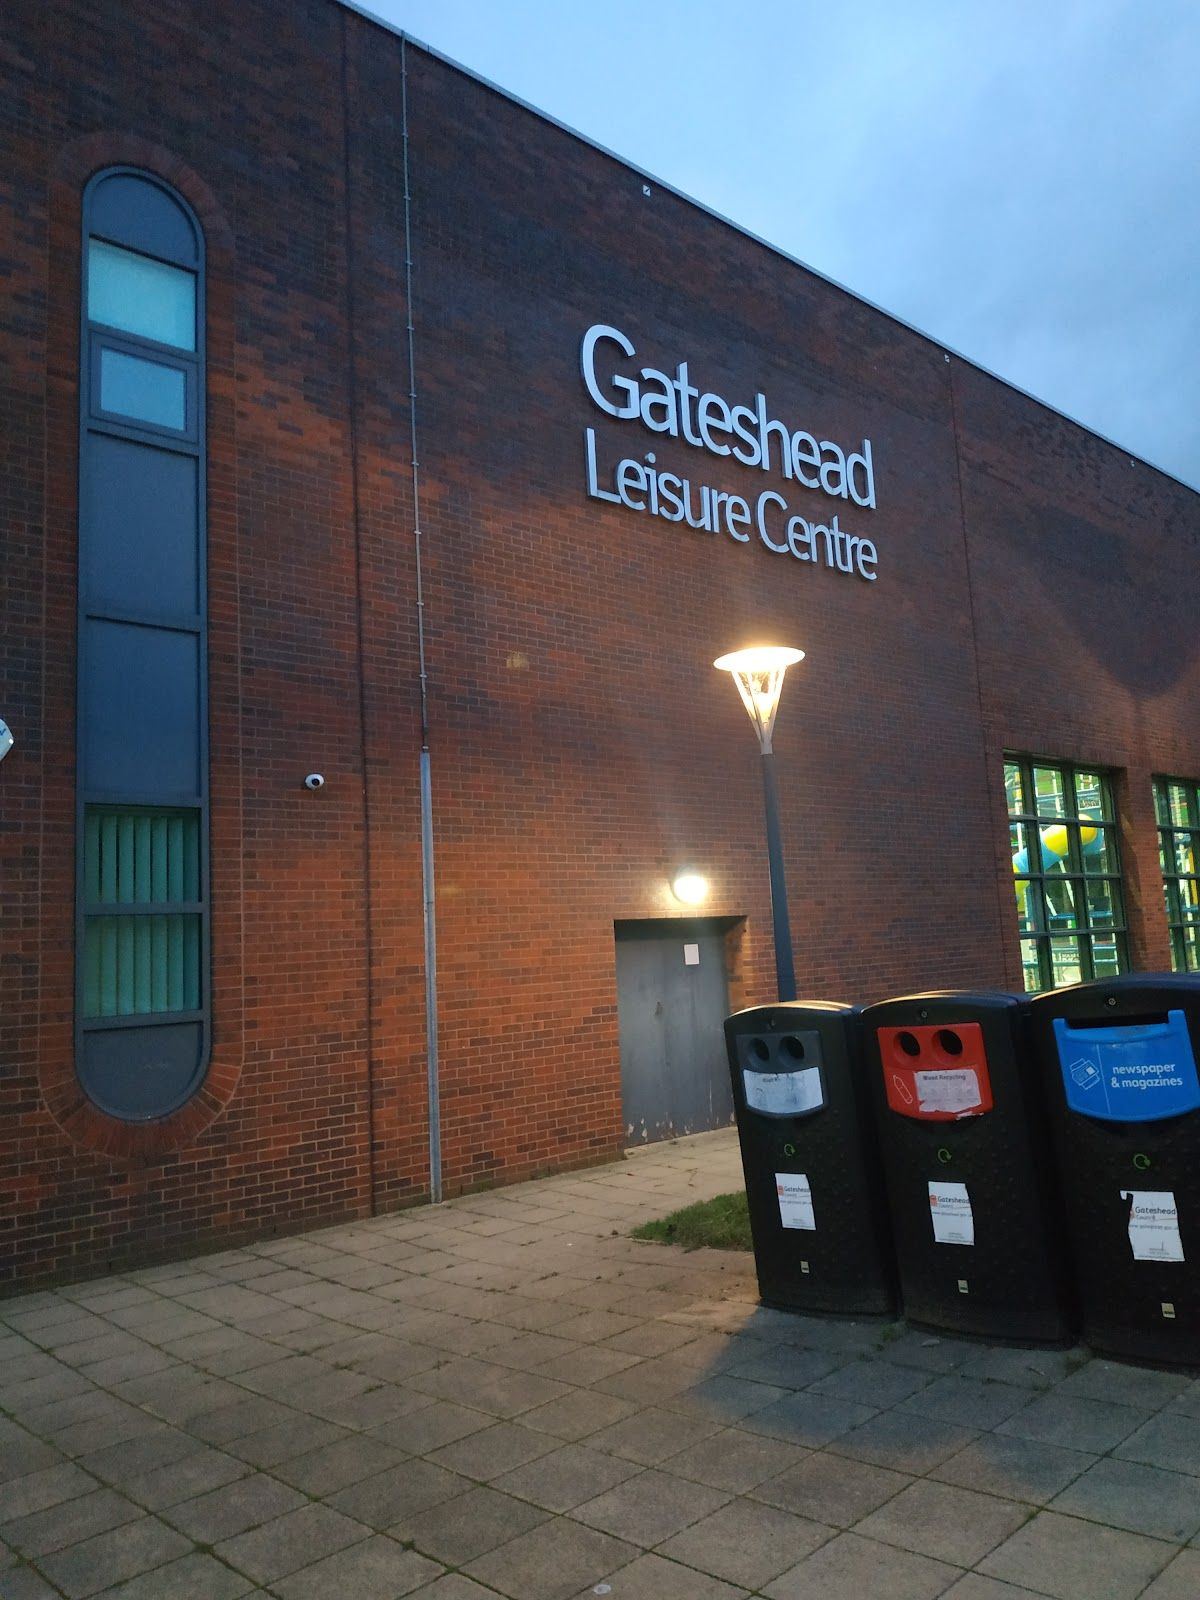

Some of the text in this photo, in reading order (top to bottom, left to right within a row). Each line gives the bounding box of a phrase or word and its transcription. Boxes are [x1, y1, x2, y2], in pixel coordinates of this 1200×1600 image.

[580, 324, 877, 510] Gateshead
[584, 427, 878, 581] Leisure Centre
[1112, 1063, 1176, 1077] newspaper
[1111, 1075, 1183, 1090] & magazines
[1135, 1206, 1177, 1215] Gateshead
